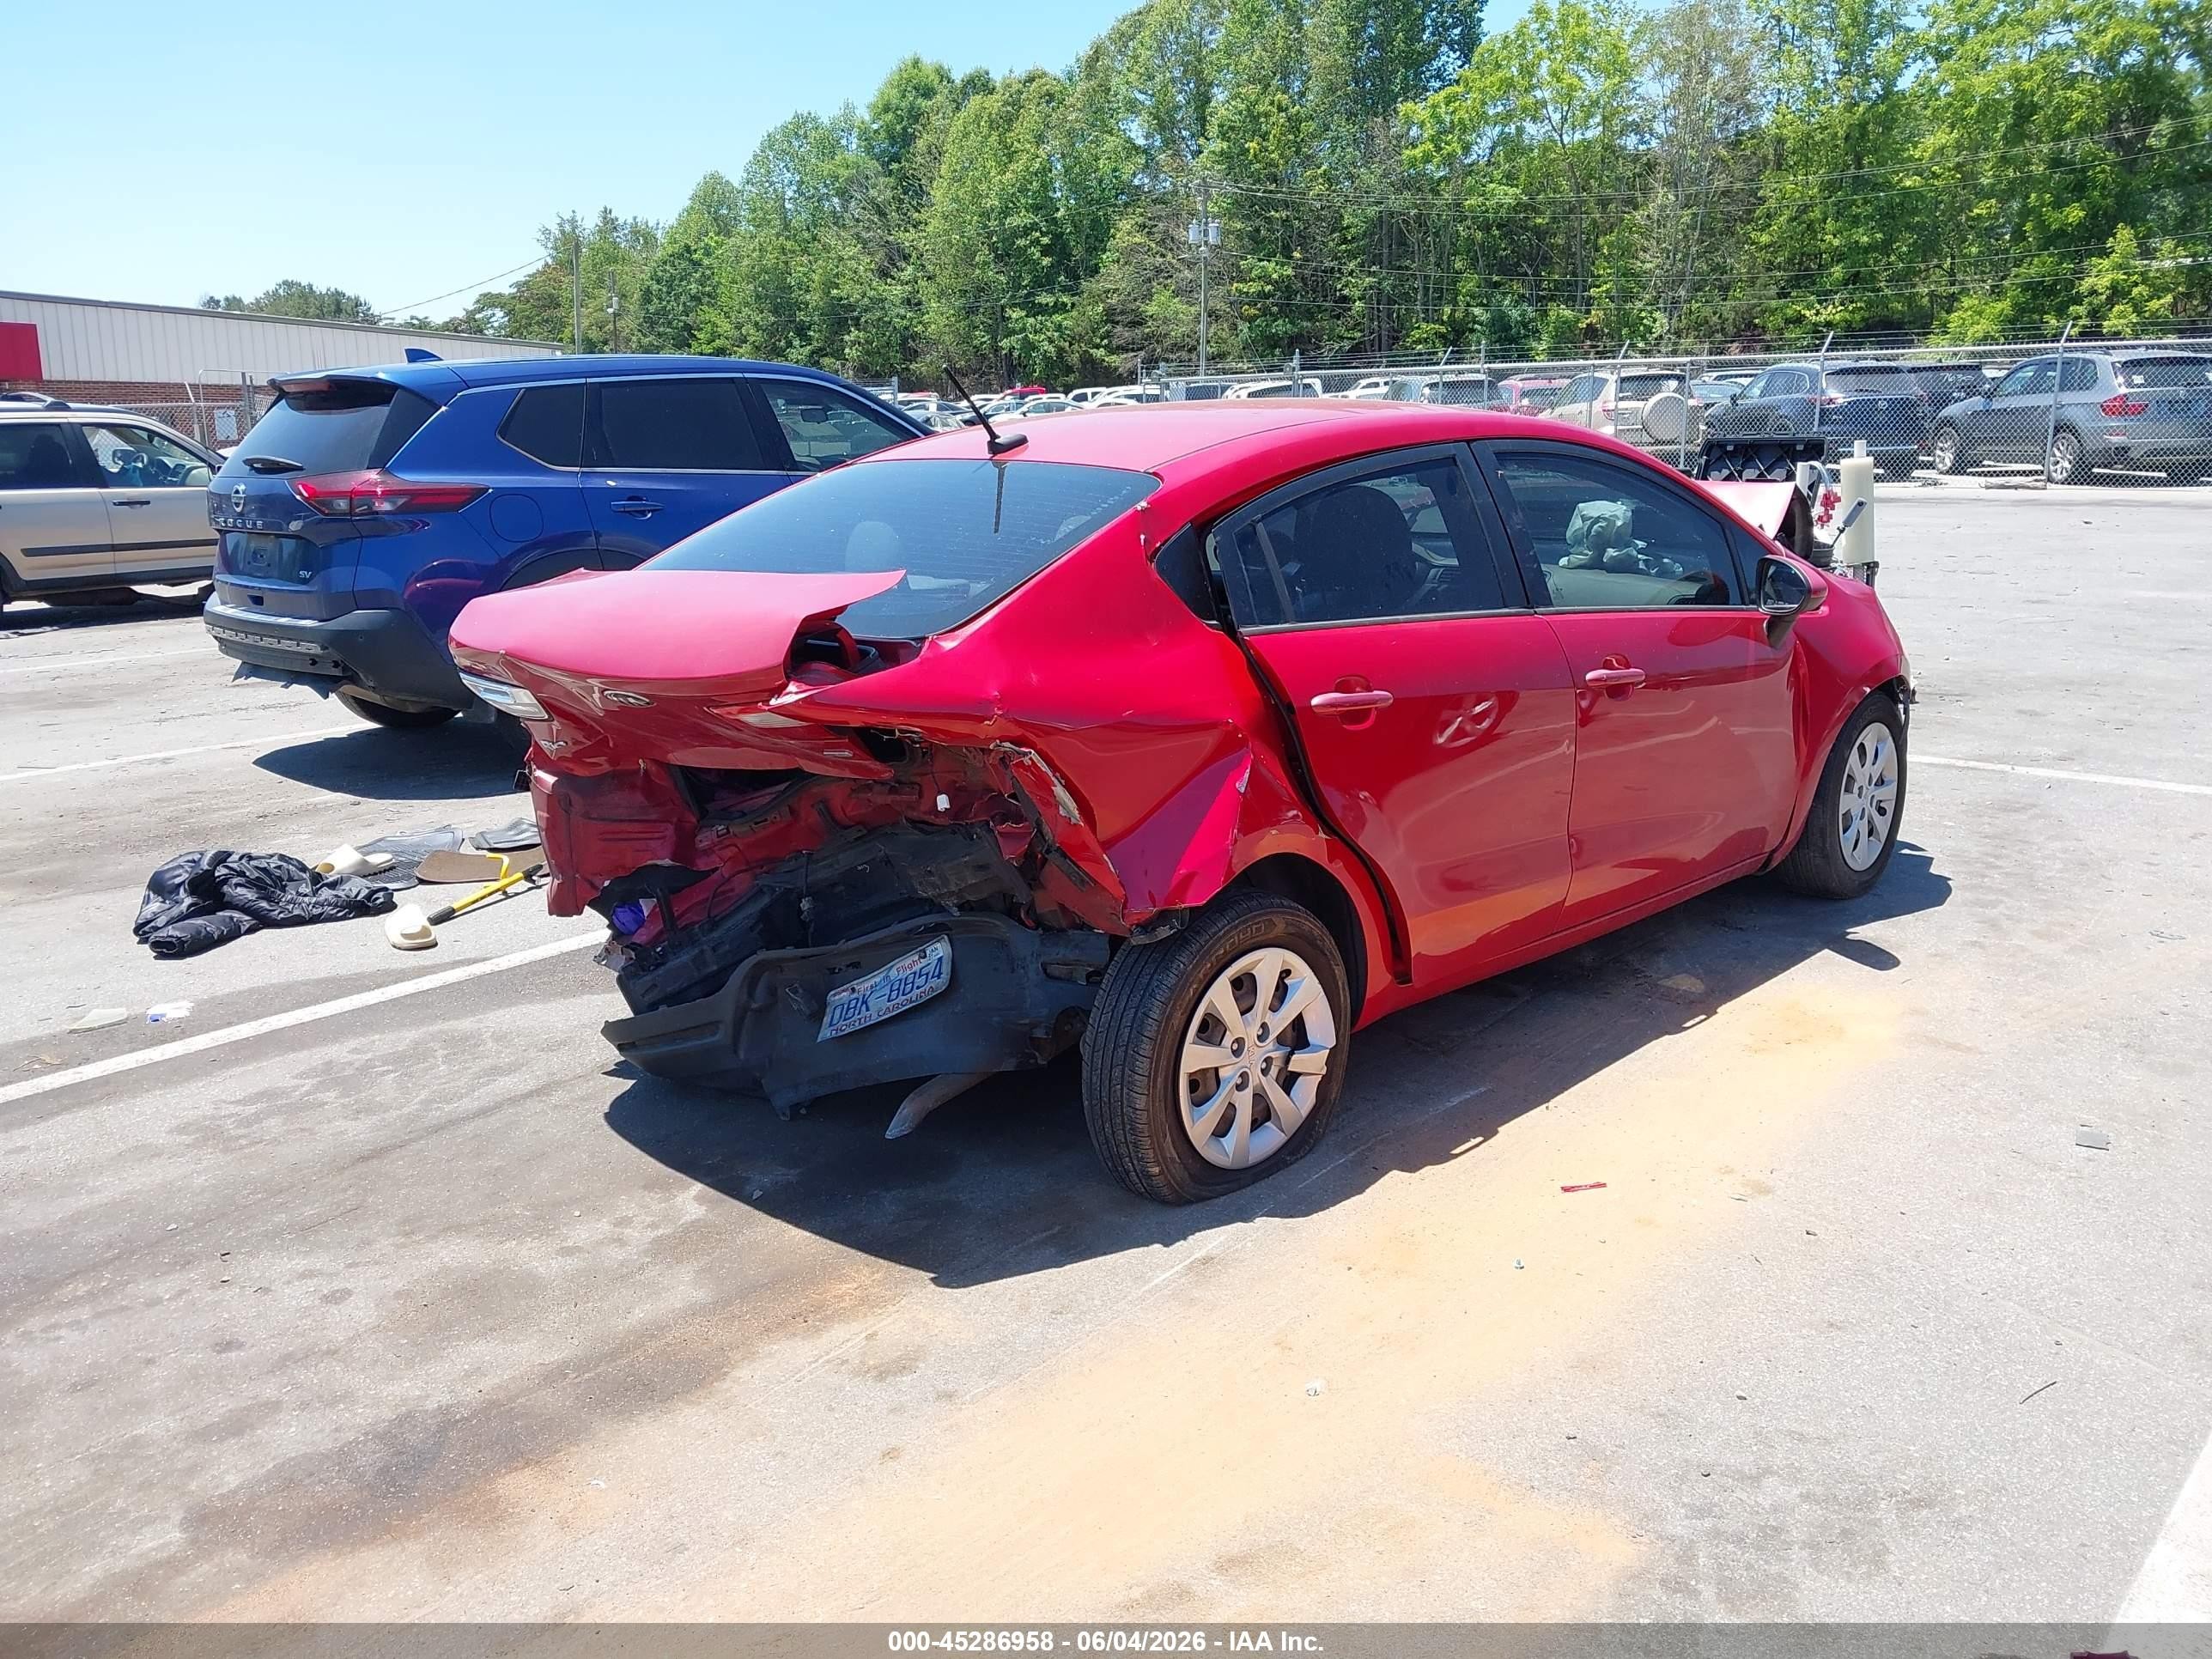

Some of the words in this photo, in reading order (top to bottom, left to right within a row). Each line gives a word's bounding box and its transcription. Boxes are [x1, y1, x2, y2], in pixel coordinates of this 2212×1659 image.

[219, 517, 264, 529] ROGUE
[299, 570, 312, 579] SV
[857, 982, 878, 996] First
[896, 957, 922, 976] Flight
[830, 1013, 872, 1036] NORTH
[877, 985, 935, 1017] CAROLINA
